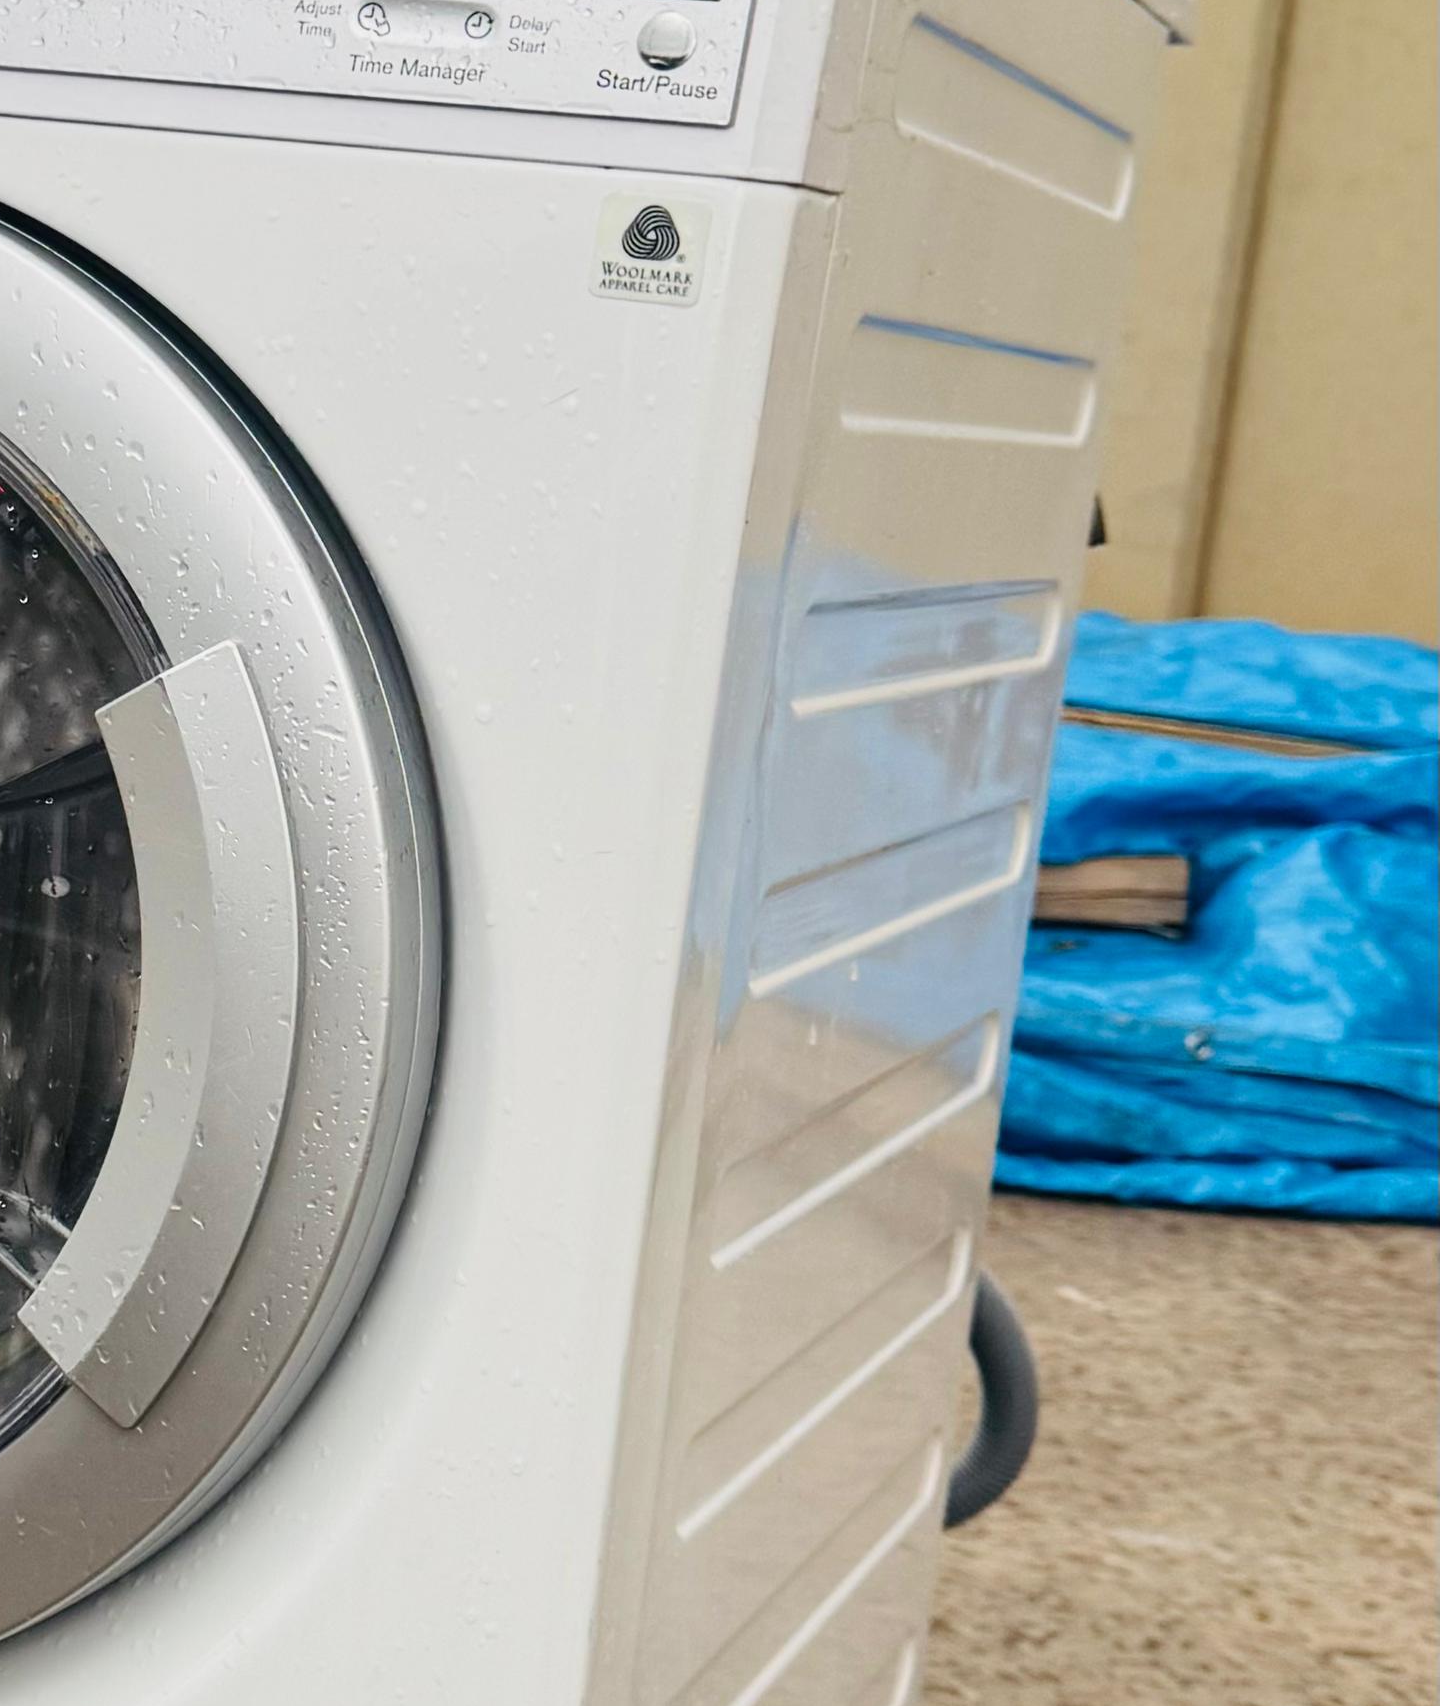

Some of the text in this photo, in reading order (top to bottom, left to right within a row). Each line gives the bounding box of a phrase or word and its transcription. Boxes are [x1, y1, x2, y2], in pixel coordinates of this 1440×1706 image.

[294, 0, 342, 17] Adjust
[297, 21, 332, 38] Time
[509, 15, 554, 34] Delay
[507, 38, 545, 54] Start
[349, 54, 486, 85] Time Manager
[596, 69, 718, 100] Start/Pause
[602, 261, 693, 285] WOOLMARK
[599, 279, 689, 297] APPAREL CARE
